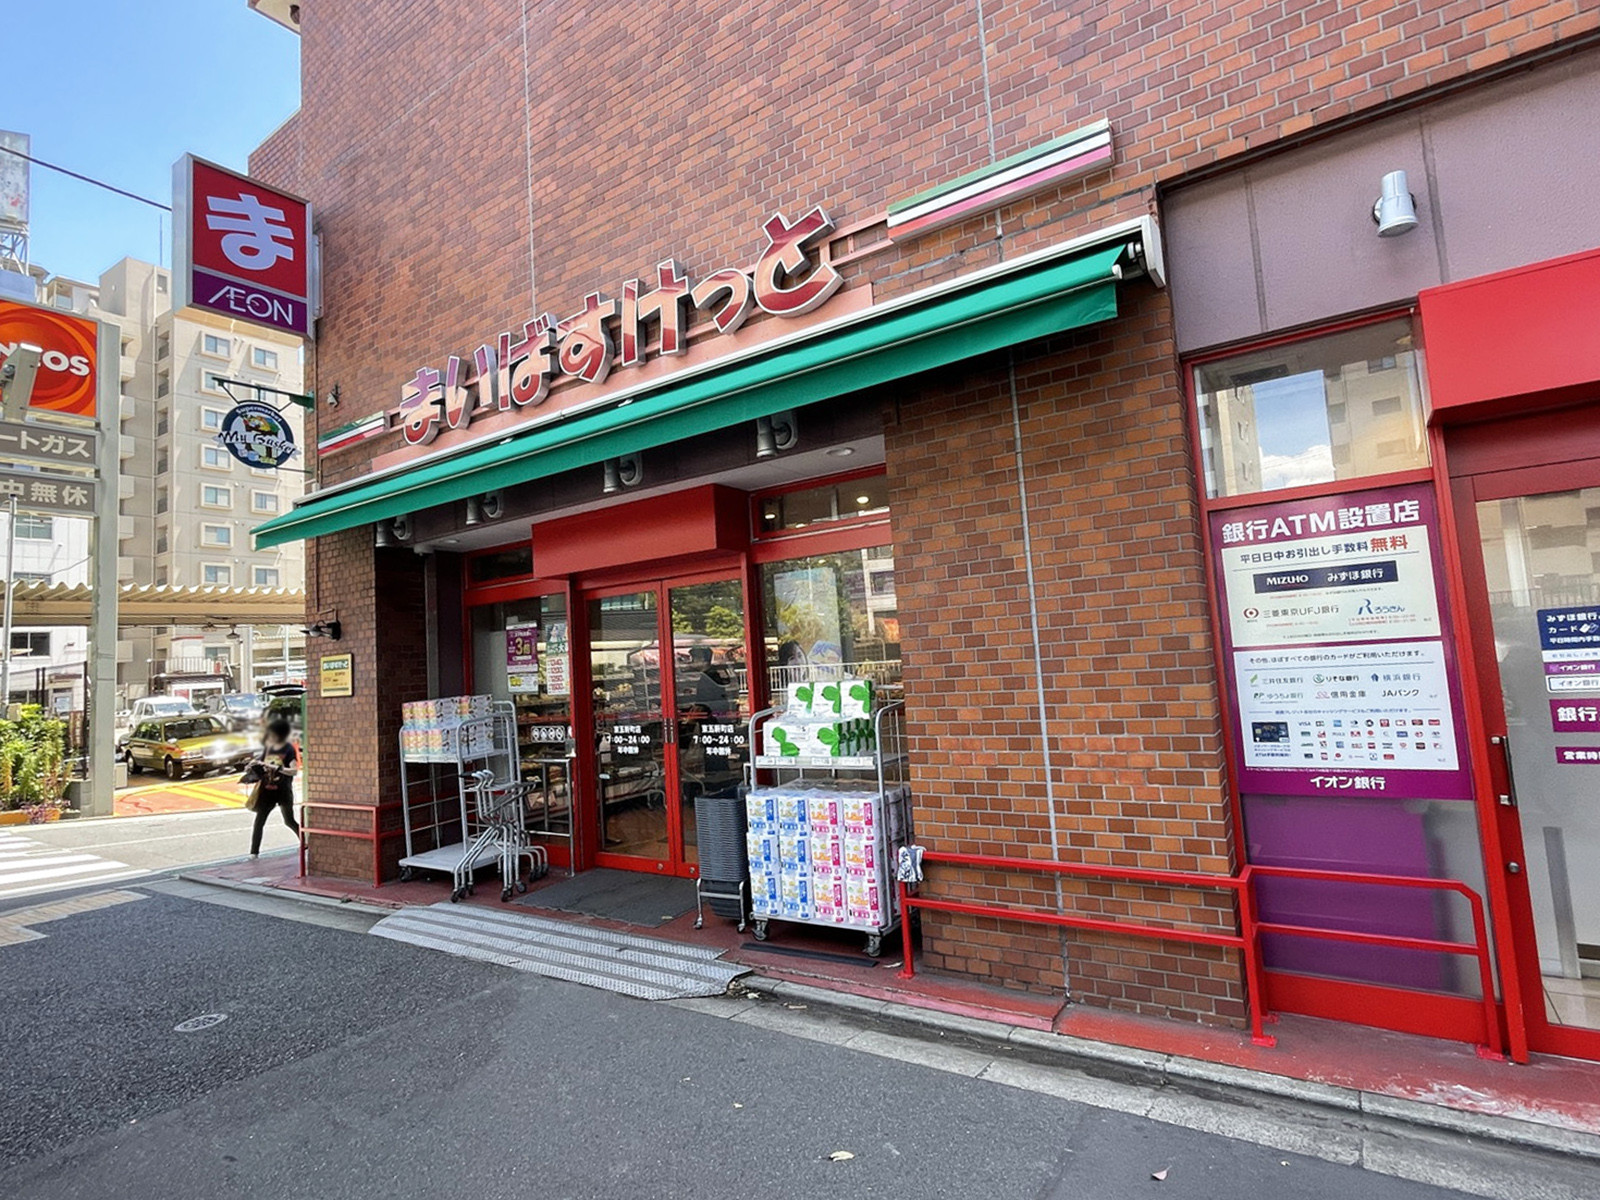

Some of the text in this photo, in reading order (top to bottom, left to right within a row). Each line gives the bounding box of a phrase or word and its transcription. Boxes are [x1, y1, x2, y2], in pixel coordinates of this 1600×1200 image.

[206, 193, 295, 271] ま
[400, 205, 844, 446] まいばすけっと
[1221, 500, 1420, 544] 銀行ATM設置店
[1266, 567, 1384, 586] MIZUHO みずほ銀行
[1381, 688, 1420, 699] JAバンク
[1310, 775, 1386, 790] イオン銀行
